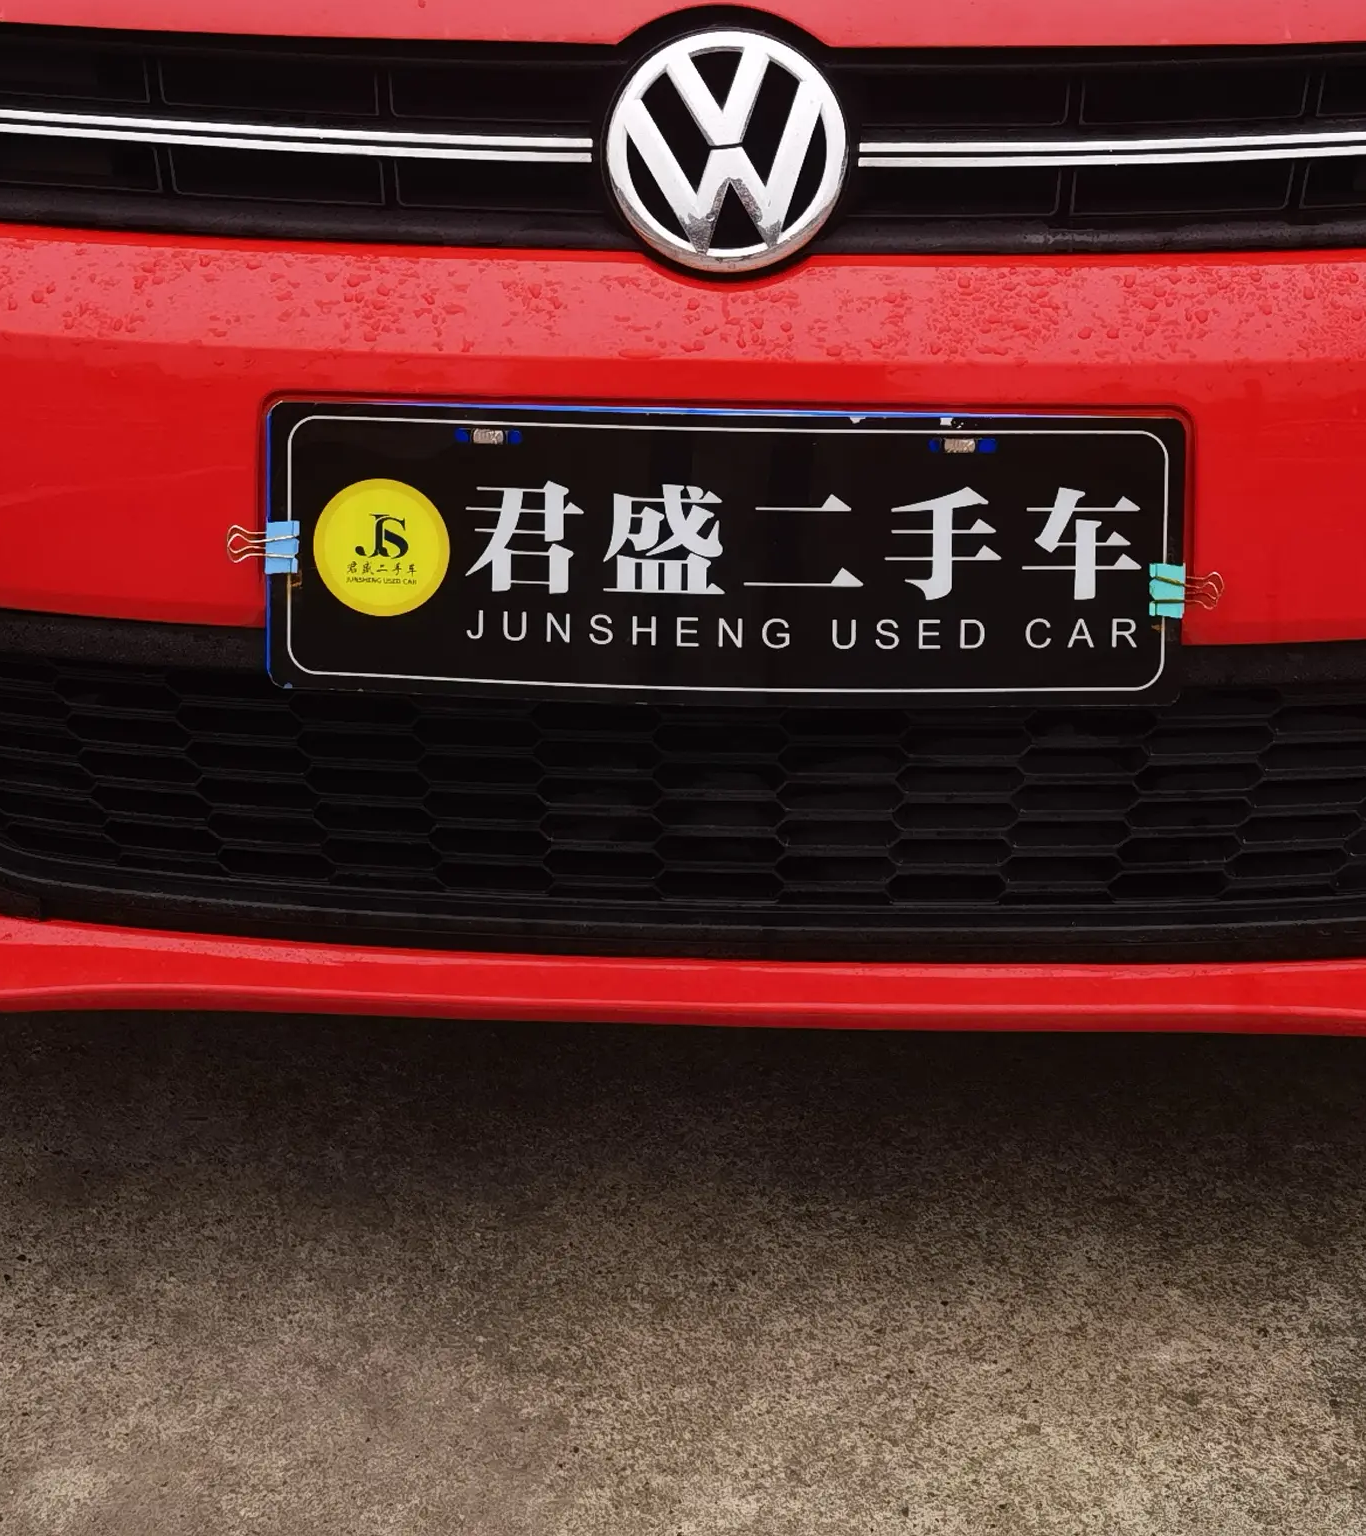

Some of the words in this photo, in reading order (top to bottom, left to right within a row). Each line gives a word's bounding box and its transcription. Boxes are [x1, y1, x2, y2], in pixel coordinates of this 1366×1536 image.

[355, 513, 409, 560] JS
[466, 480, 1143, 602] 君盛二手车
[346, 560, 417, 576] 君盛二手车
[383, 577, 401, 585] USED
[466, 609, 792, 650] JUNSHENG
[831, 618, 987, 651] USED
[1026, 618, 1138, 650] CAR
